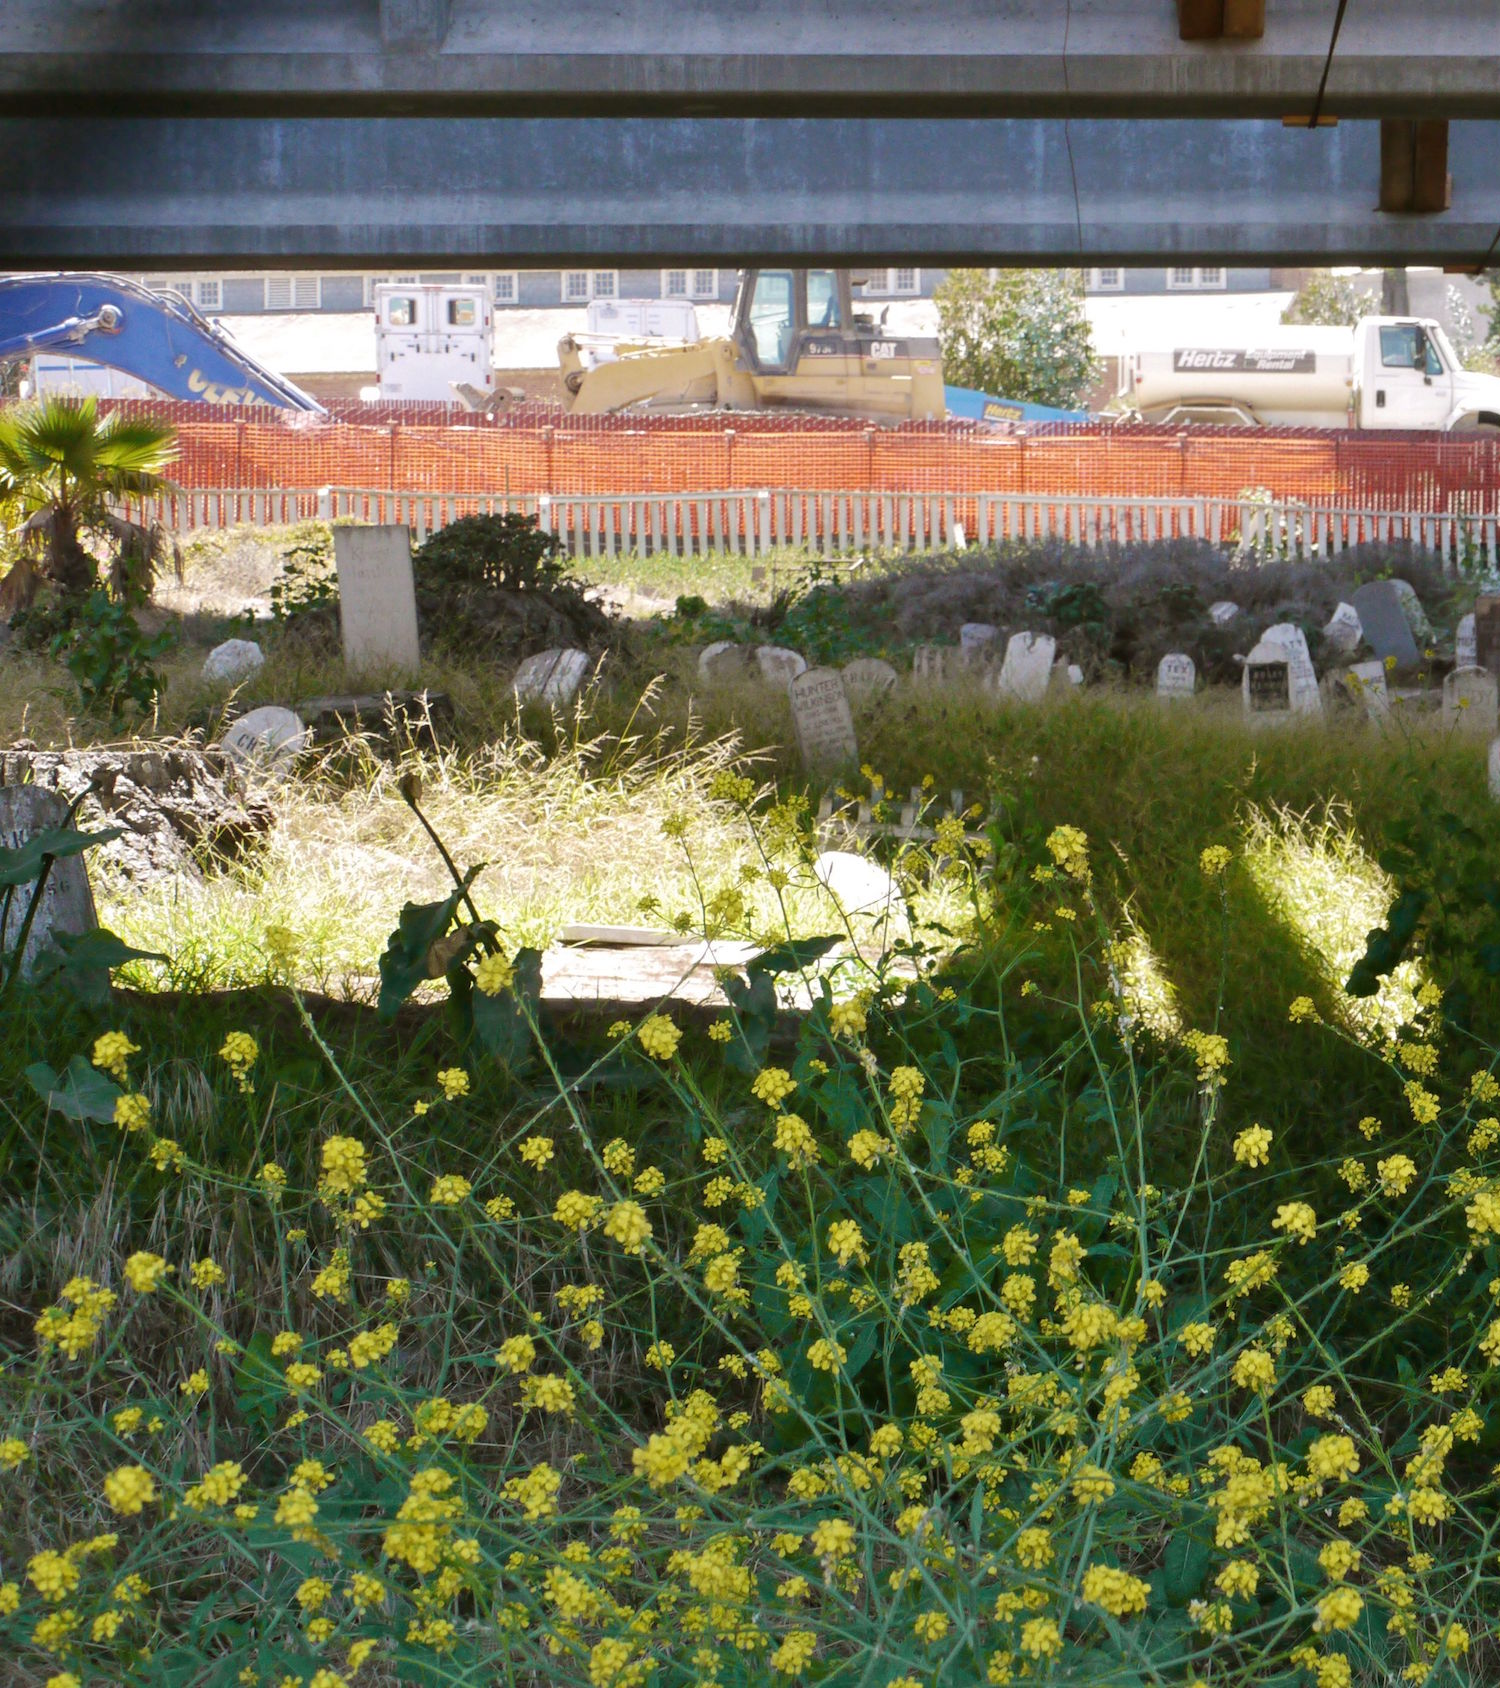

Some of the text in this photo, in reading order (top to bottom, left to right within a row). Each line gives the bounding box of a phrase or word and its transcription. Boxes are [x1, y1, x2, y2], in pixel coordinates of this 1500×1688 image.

[870, 341, 898, 359] CAT
[1178, 349, 1238, 368] Hertz
[1256, 359, 1296, 370] Rental
[795, 679, 840, 699] HUNTER
